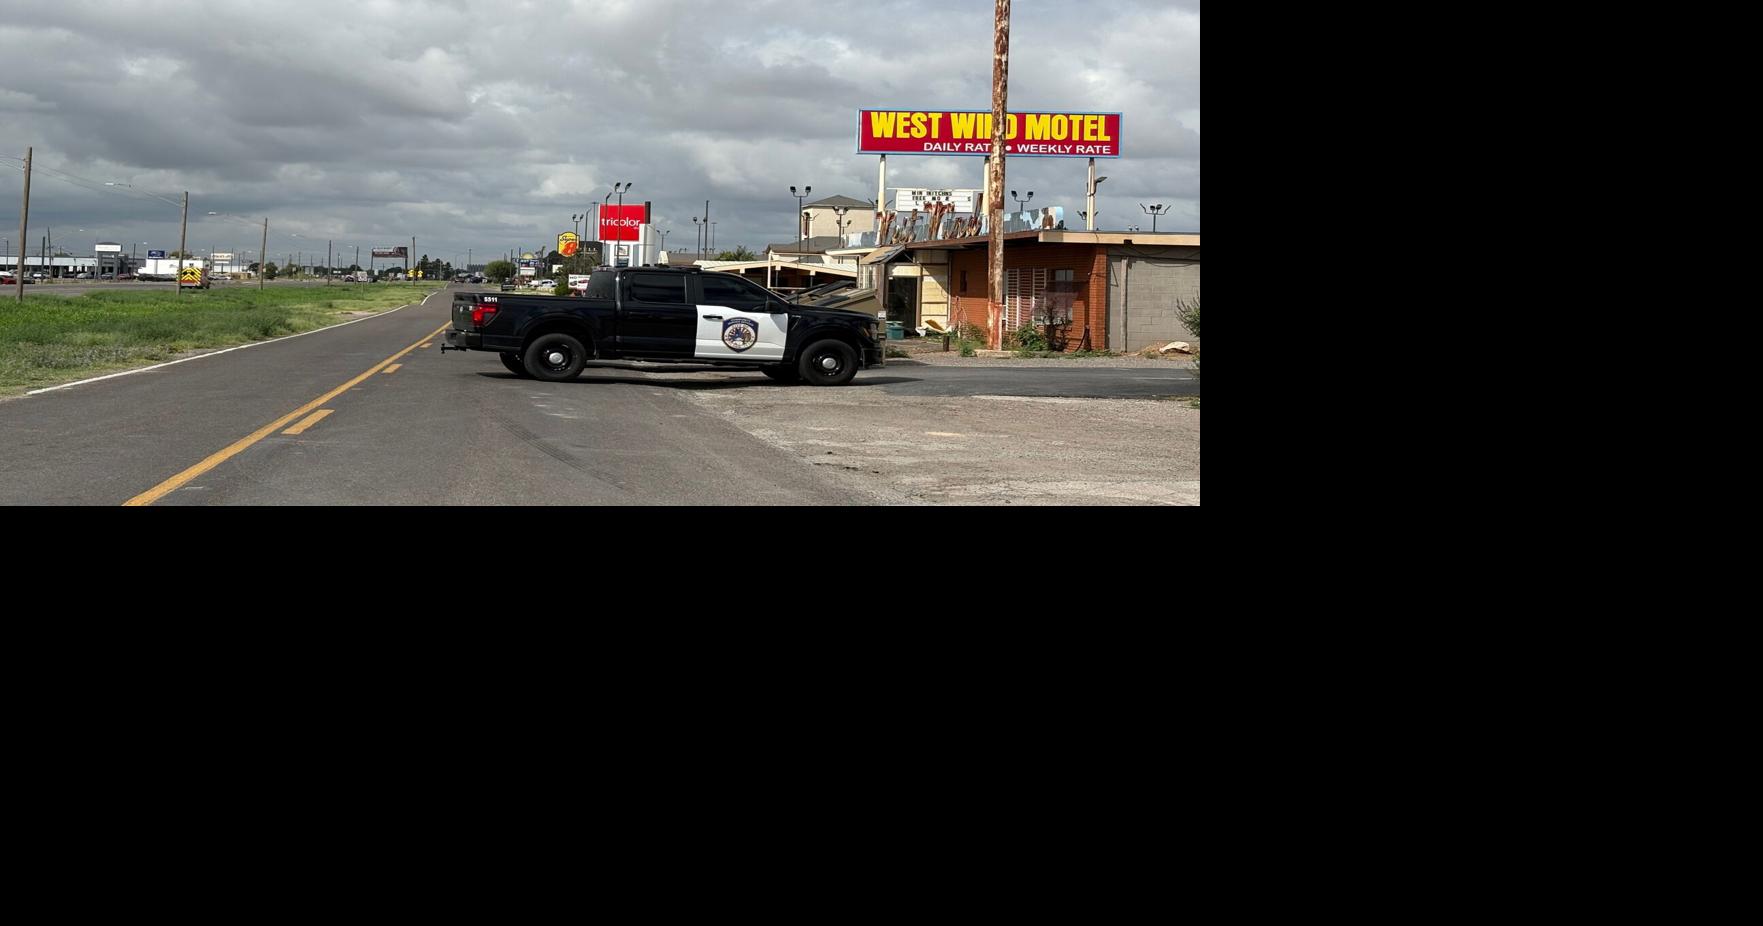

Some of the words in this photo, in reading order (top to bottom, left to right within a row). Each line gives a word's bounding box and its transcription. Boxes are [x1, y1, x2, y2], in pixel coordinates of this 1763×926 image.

[870, 112, 942, 139] WEST
[1025, 114, 1111, 142] MOTEL
[924, 142, 962, 152] DAILY
[965, 143, 992, 152] RAT
[1017, 144, 1073, 154] WEEKLY
[1076, 145, 1111, 154] RATE
[601, 217, 640, 227] tricolor
